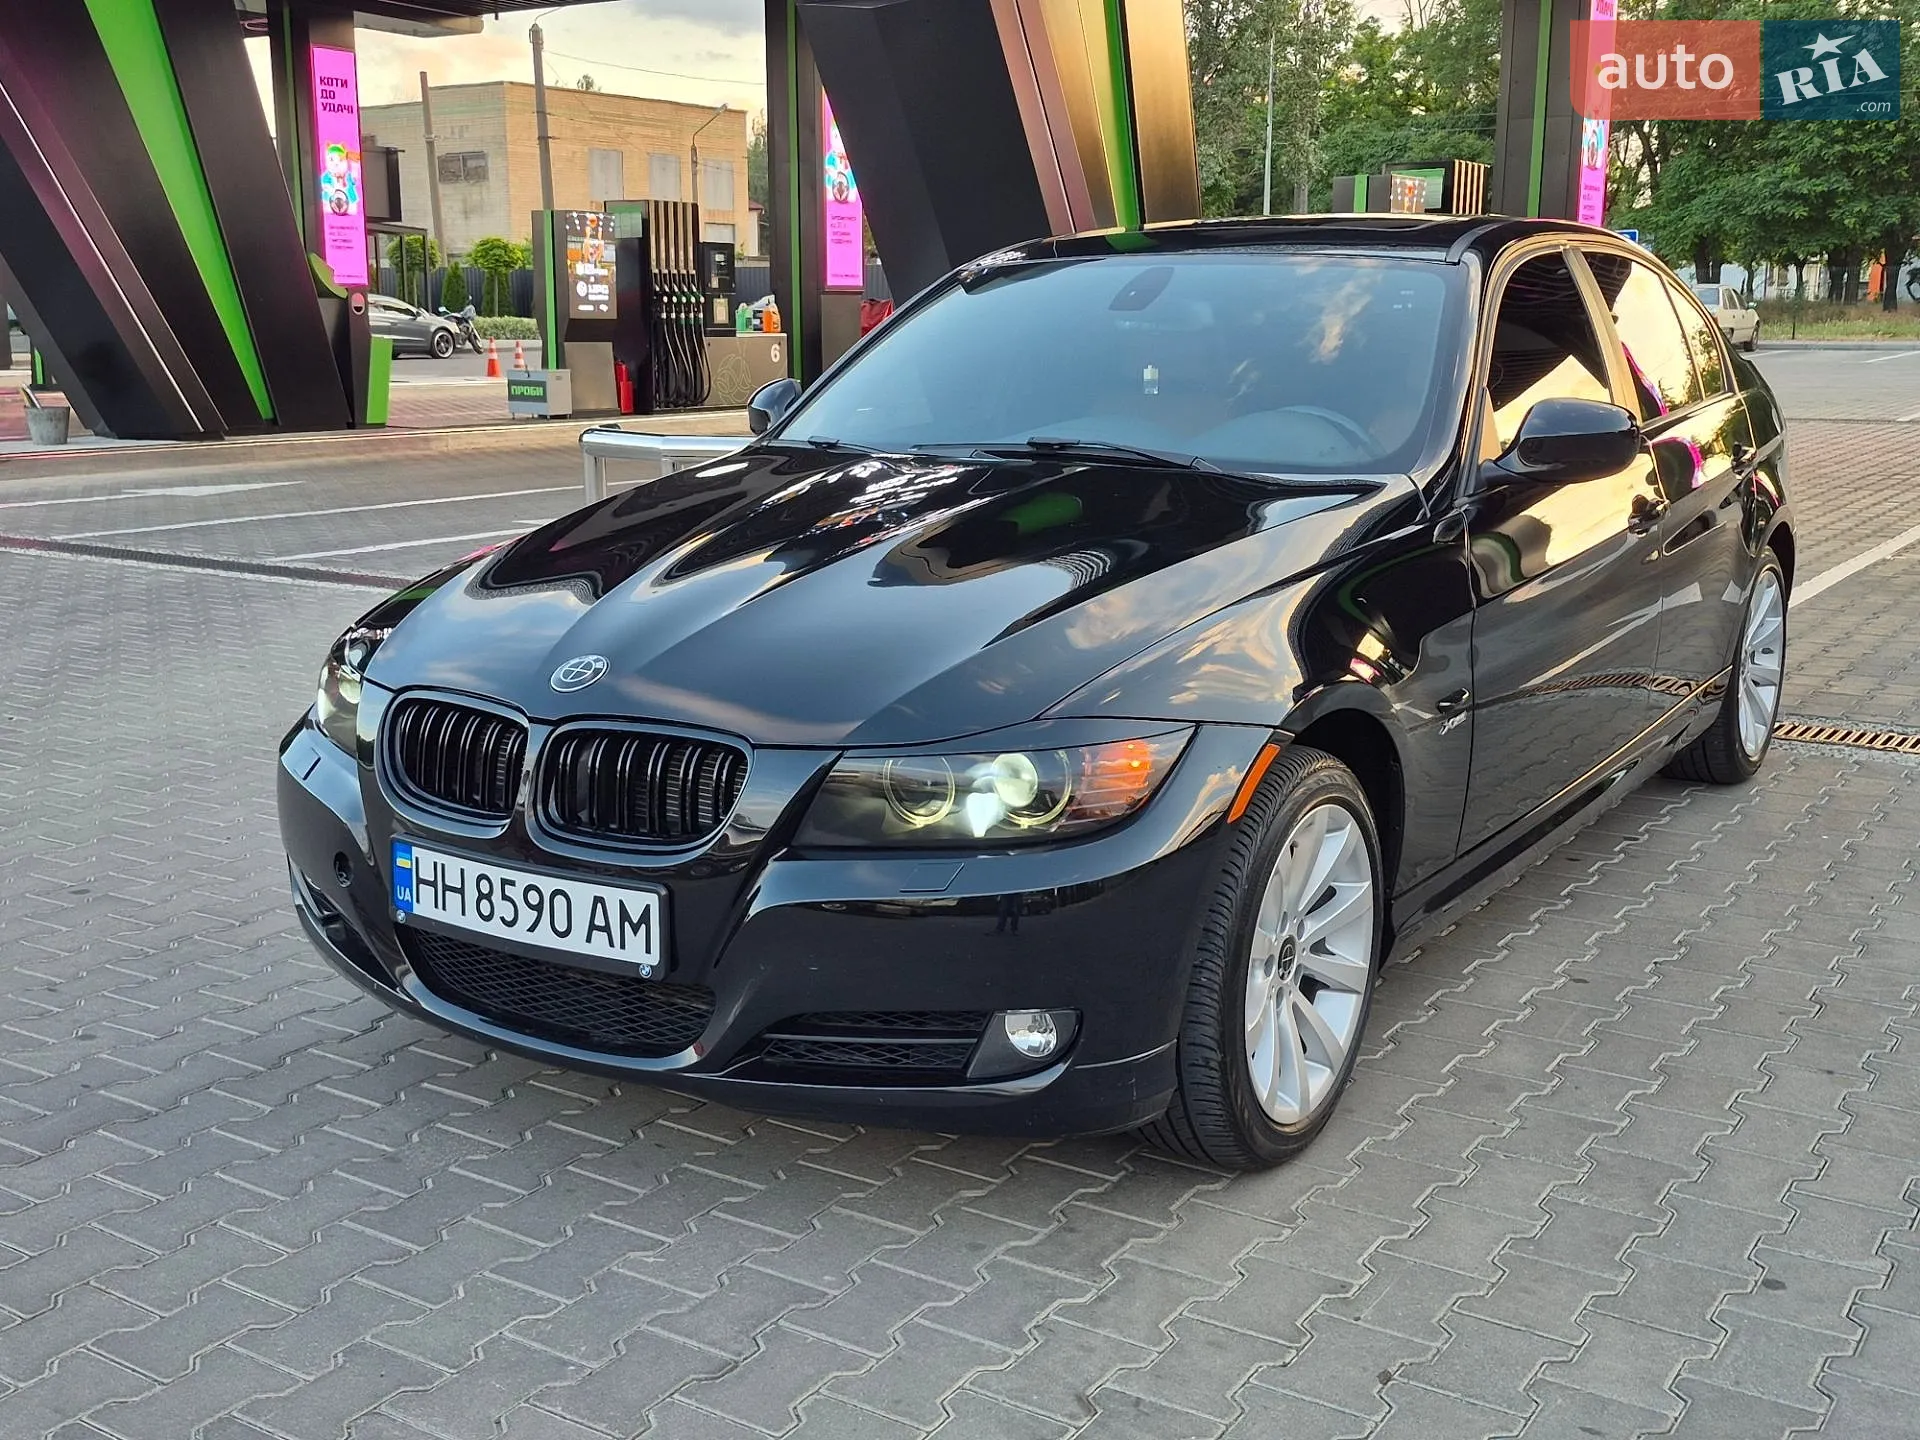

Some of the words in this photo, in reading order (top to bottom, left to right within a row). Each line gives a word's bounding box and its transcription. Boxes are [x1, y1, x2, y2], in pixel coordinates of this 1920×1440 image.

[319, 75, 349, 89] КОТИ
[320, 89, 336, 101] ДО
[321, 102, 355, 115] УДАЧІ
[770, 343, 781, 363] 6
[511, 385, 544, 397] ПРОБИ
[396, 886, 412, 904] UA
[475, 873, 573, 939] 8590
[585, 895, 652, 955] AM
